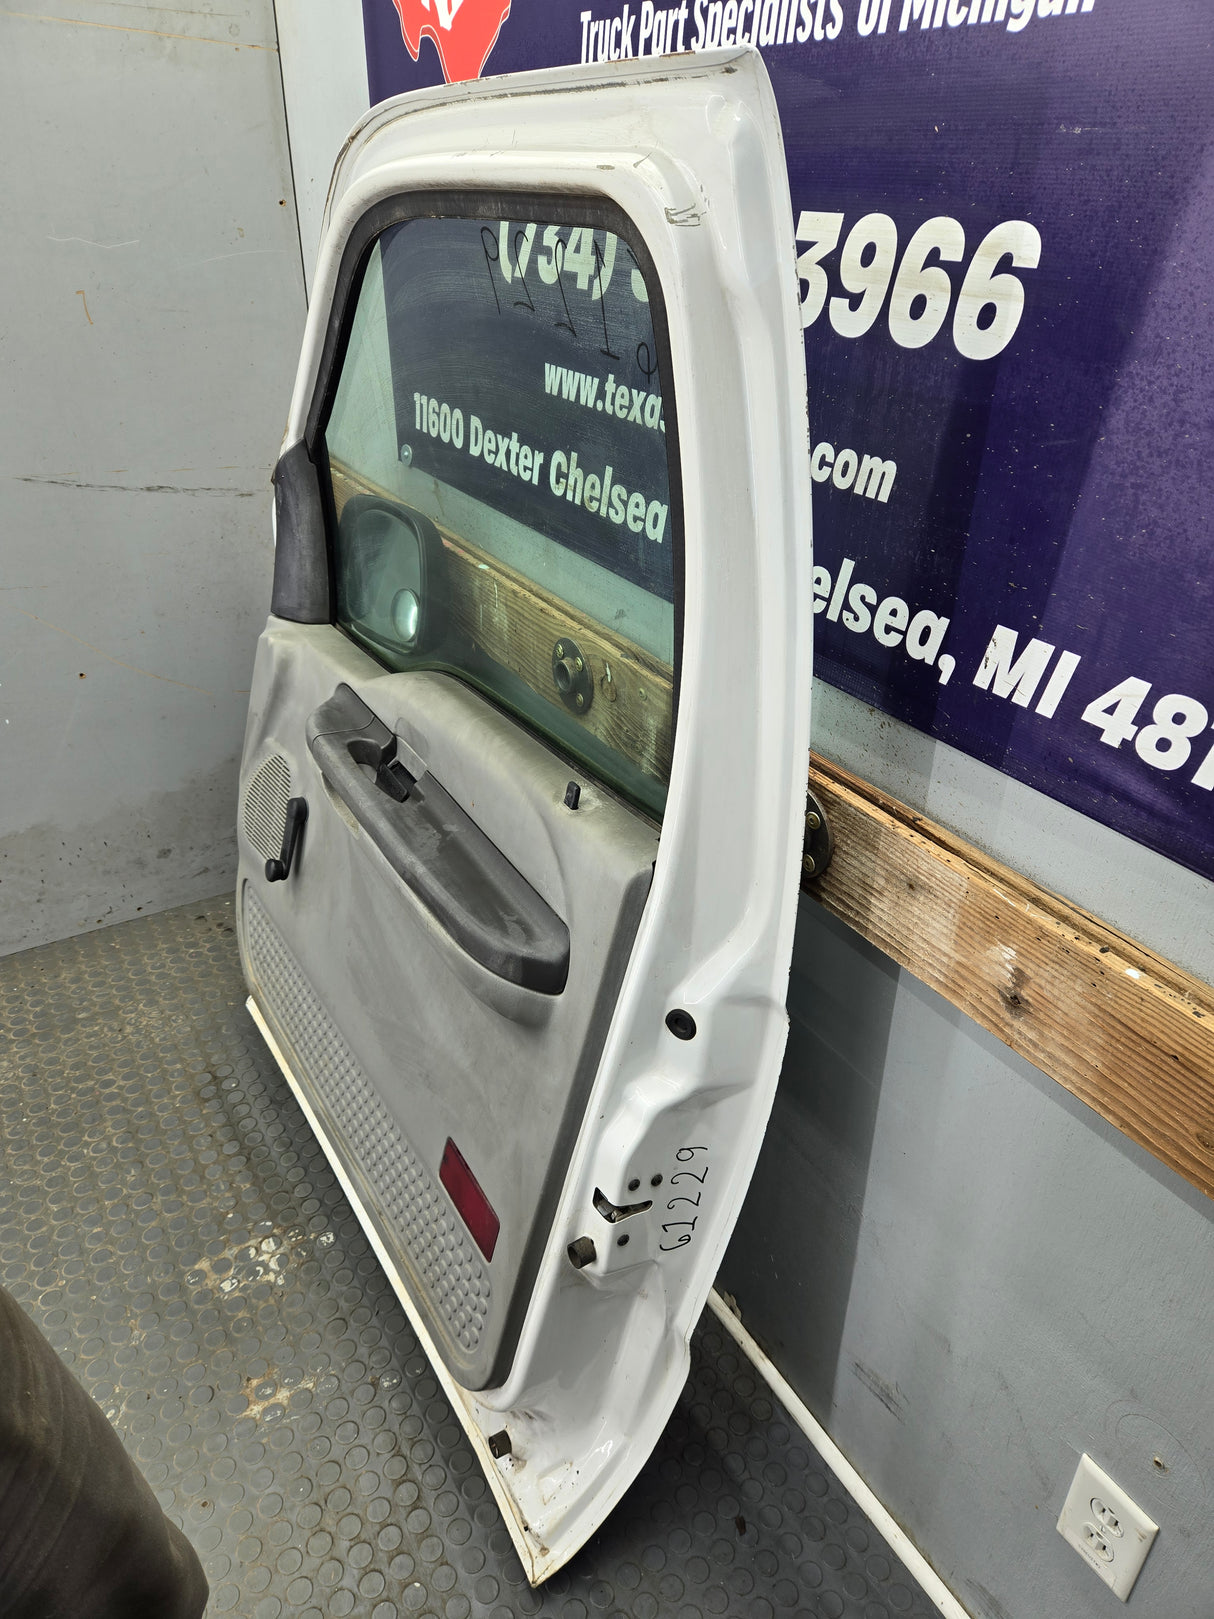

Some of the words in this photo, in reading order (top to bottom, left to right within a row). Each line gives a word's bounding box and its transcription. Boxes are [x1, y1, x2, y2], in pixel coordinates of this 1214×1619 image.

[580, 5, 637, 64] Truck
[638, 0, 689, 57] Part
[690, 0, 844, 50] Specialists
[795, 211, 1042, 361] 3966
[544, 362, 666, 433] www.texa
[810, 441, 898, 503] com
[413, 392, 464, 449] 11600
[469, 415, 544, 486] Dexter
[549, 450, 669, 543] Chelsea
[813, 557, 956, 686] elsea,
[972, 624, 1082, 719] MI
[659, 1146, 709, 1251] 61229
